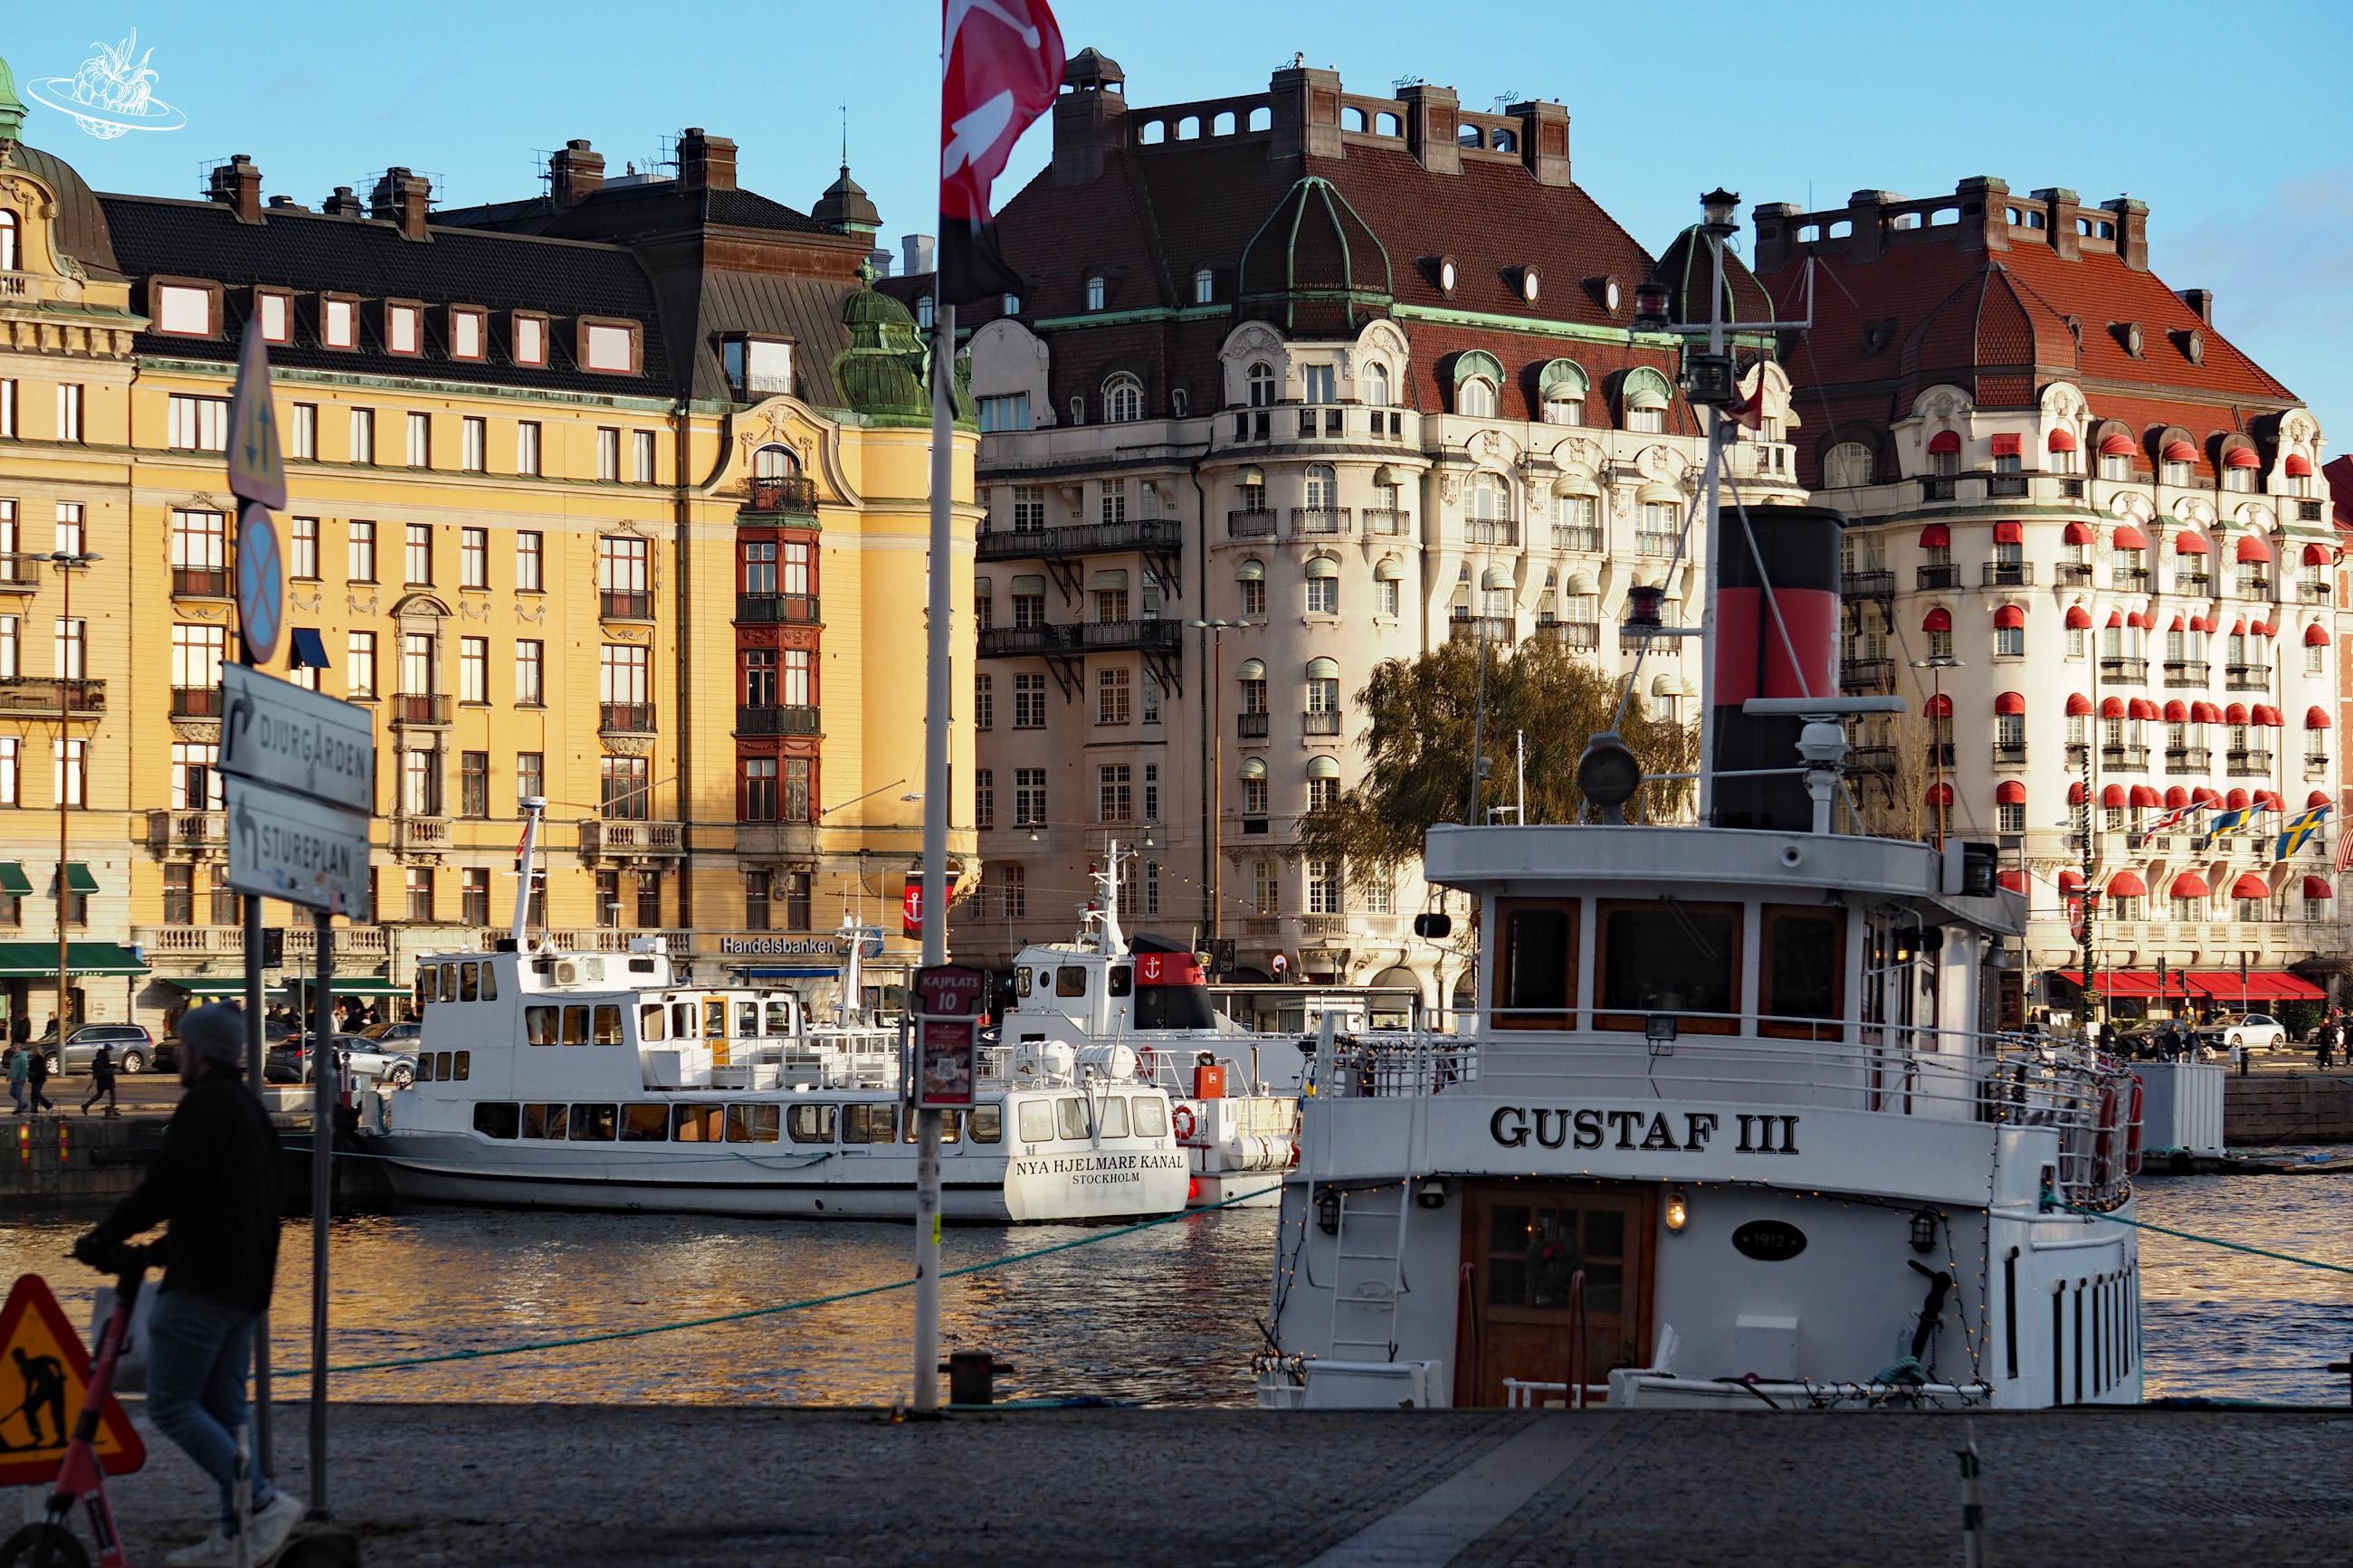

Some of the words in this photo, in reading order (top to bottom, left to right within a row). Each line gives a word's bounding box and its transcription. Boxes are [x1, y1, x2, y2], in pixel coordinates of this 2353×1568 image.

[260, 714, 366, 780] DJURGÅRDEN
[262, 824, 351, 878] STUREPLAN
[723, 937, 836, 954] Handelsbanken
[922, 975, 978, 989] KAJPLATS
[938, 992, 957, 1011] 10
[1490, 1106, 1719, 1152] GUSTAF
[1735, 1114, 1799, 1155] III
[1016, 1161, 1049, 1175] NYA
[1053, 1155, 1137, 1173] HJELMARE
[1140, 1155, 1184, 1169] KANAL
[1072, 1172, 1139, 1184] STOCKHOLM
[1755, 1233, 1786, 1247] 1912
